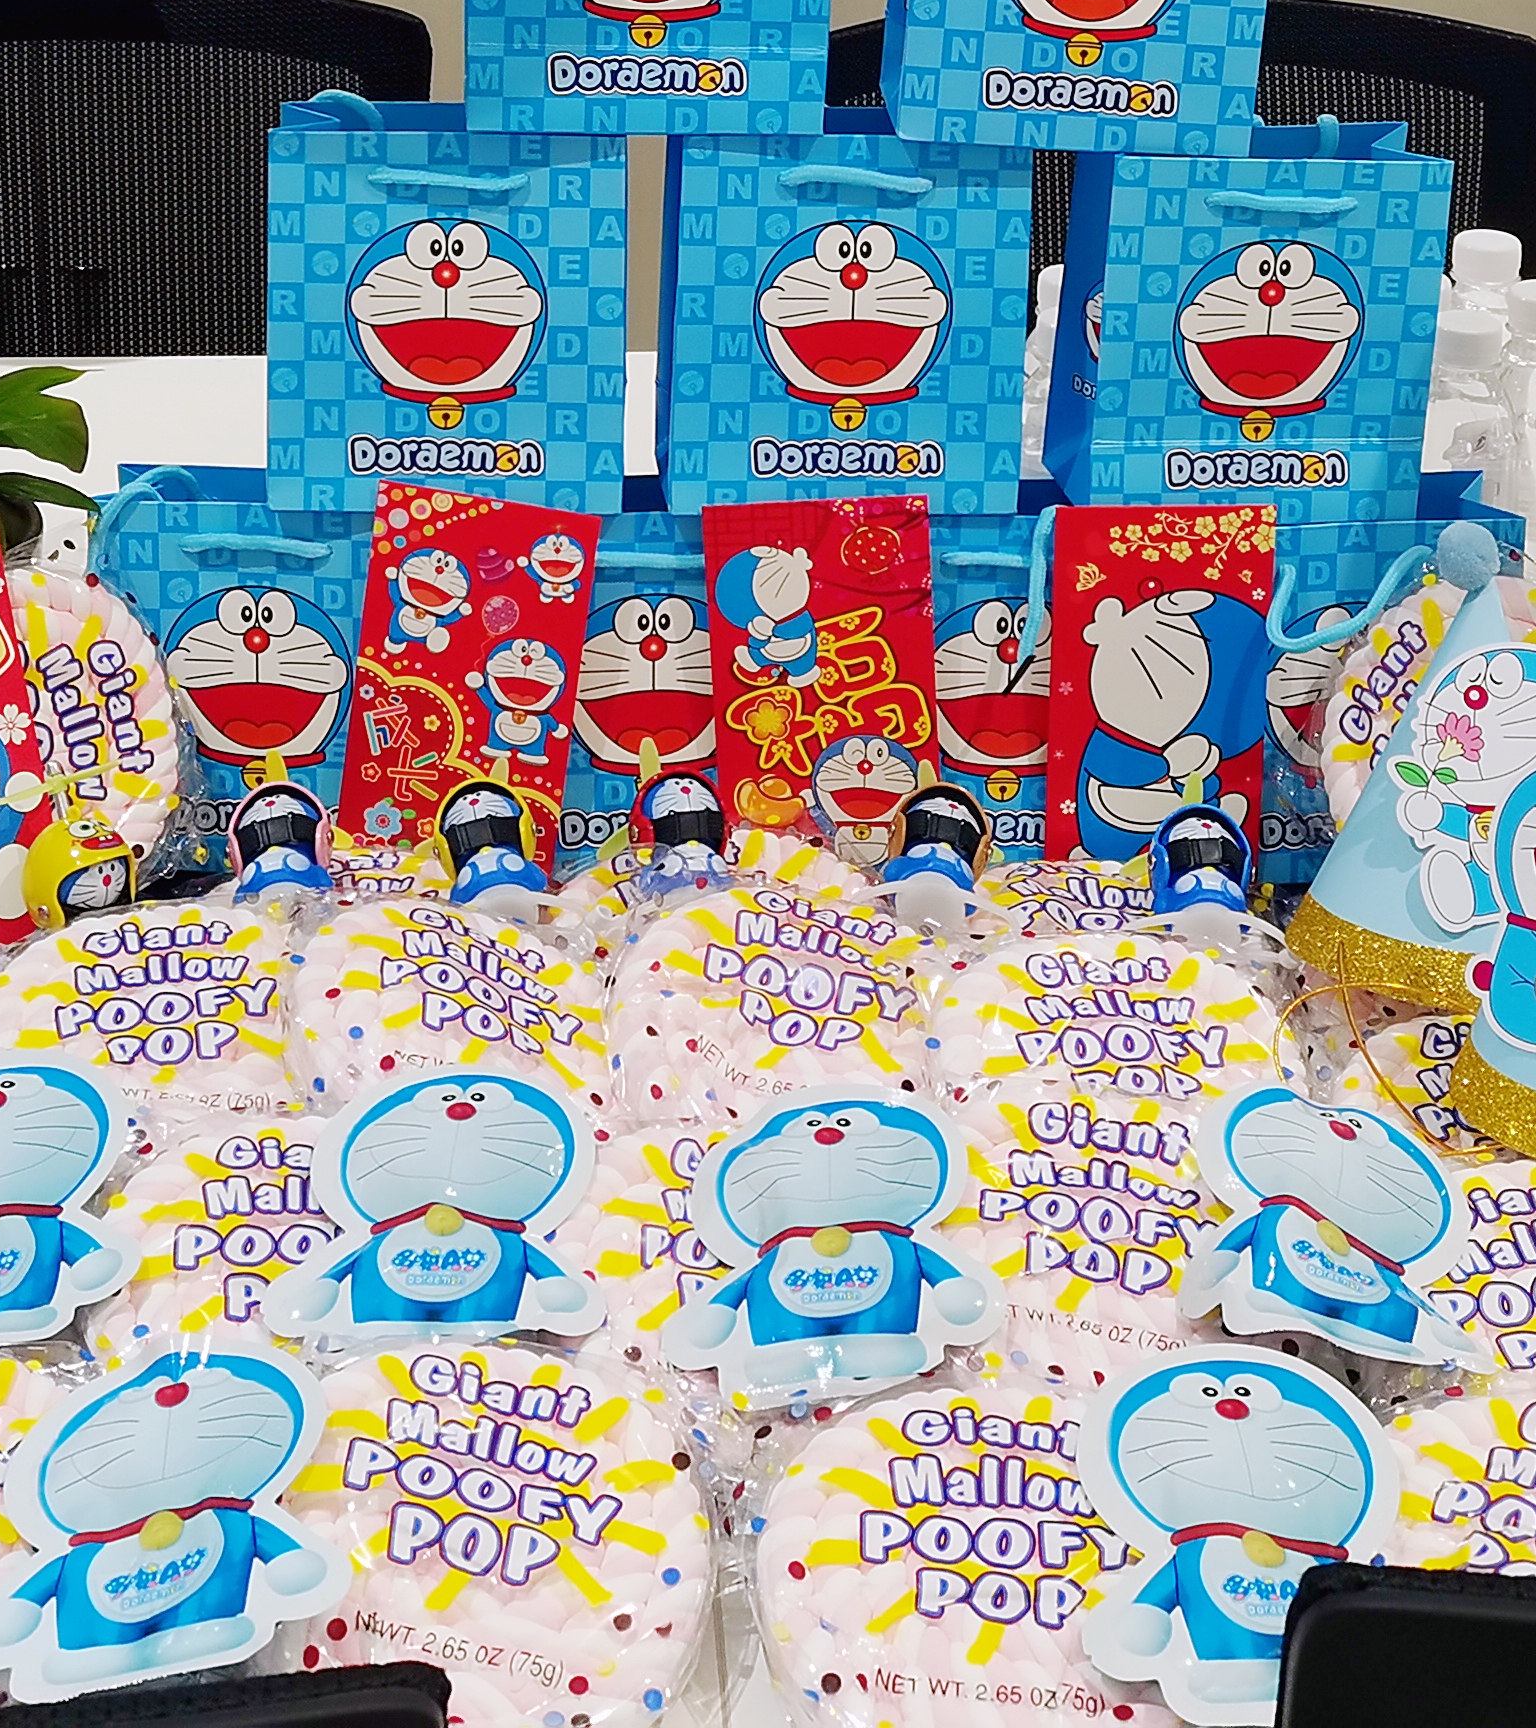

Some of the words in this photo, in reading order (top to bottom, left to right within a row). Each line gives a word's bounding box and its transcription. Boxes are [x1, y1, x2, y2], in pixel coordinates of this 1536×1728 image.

[548, 52, 748, 99] Doraemon
[982, 68, 1178, 120] Doraemon
[351, 436, 544, 476] Doraemon
[753, 439, 944, 478] Doraemon
[1165, 449, 1349, 490] Doraemon
[87, 640, 154, 772] Giant
[1338, 619, 1428, 742] Giant
[35, 643, 107, 800] Mallow
[83, 922, 233, 957] Giant
[409, 907, 545, 973] Giant
[754, 888, 898, 947] Giant
[75, 953, 247, 995] Mallow
[402, 930, 558, 1005] Mallow
[705, 944, 919, 1023] POOFY
[1025, 952, 1171, 989] Giant
[56, 978, 278, 1041] POOFY
[380, 956, 584, 1045] POOFY
[422, 991, 545, 1056] POP
[740, 989, 864, 1050] POP
[1025, 990, 1196, 1026] Mallow
[109, 1022, 238, 1066] POP
[695, 1033, 726, 1069] NET
[1014, 1022, 1229, 1069] POOFY
[215, 1136, 314, 1172] Gia
[1028, 1101, 1190, 1165] Giant
[1009, 1149, 1201, 1210] Mallow
[979, 1188, 1220, 1259] POOFY
[1025, 1231, 1172, 1295] POP
[1108, 1324, 1134, 1344] OZ
[408, 1353, 592, 1426] Giant
[386, 1398, 597, 1487] Mallow
[902, 1408, 1080, 1459] Giant
[342, 1436, 624, 1546] POOFY
[386, 1503, 560, 1586] POP
[860, 1510, 1130, 1571] POOFY
[916, 1567, 1087, 1630] POP
[421, 1631, 470, 1663] 2.65
[474, 1644, 506, 1667] OZ
[509, 1649, 566, 1690] (75g)
[874, 1667, 919, 1695] NET
[974, 1683, 1023, 1705] 2.65
[1059, 1682, 1107, 1718] 75g)
